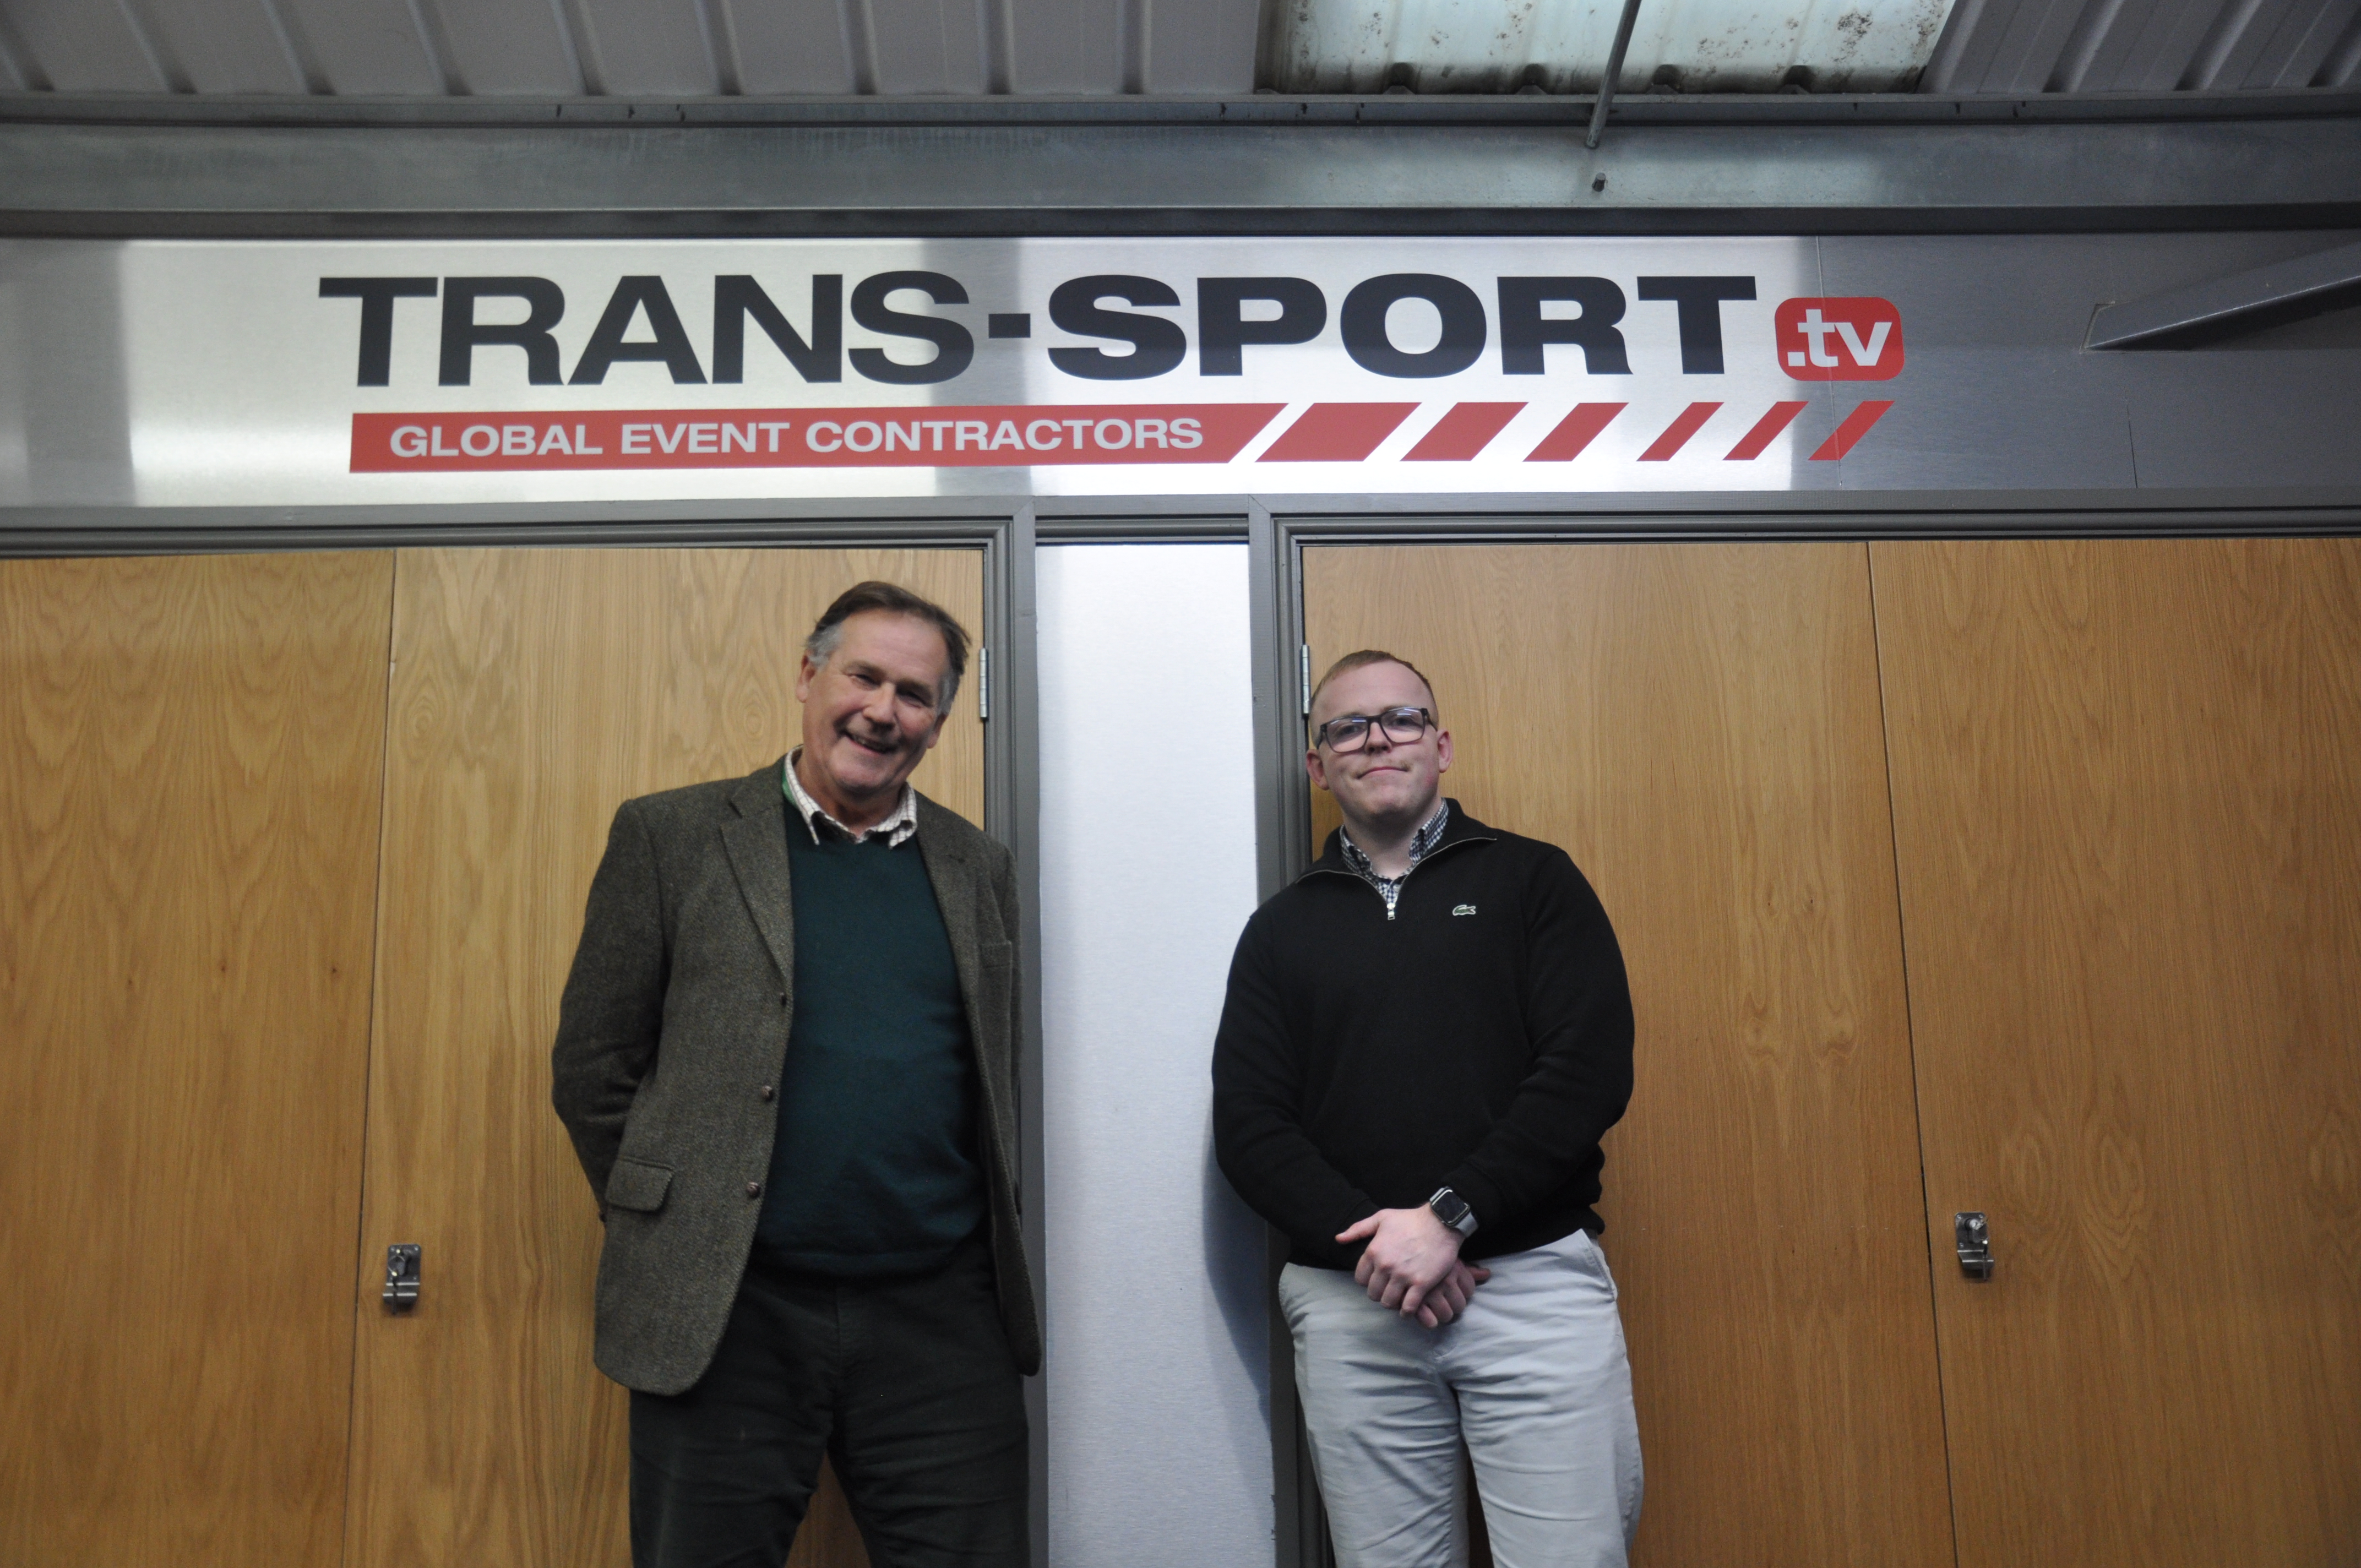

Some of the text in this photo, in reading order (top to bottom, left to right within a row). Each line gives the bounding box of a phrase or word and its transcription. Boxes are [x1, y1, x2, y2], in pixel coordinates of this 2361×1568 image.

[318, 270, 1892, 386] TRANS-SPORT .tv
[389, 417, 1204, 458] GLOBAL EVENT CONTRACTORS
